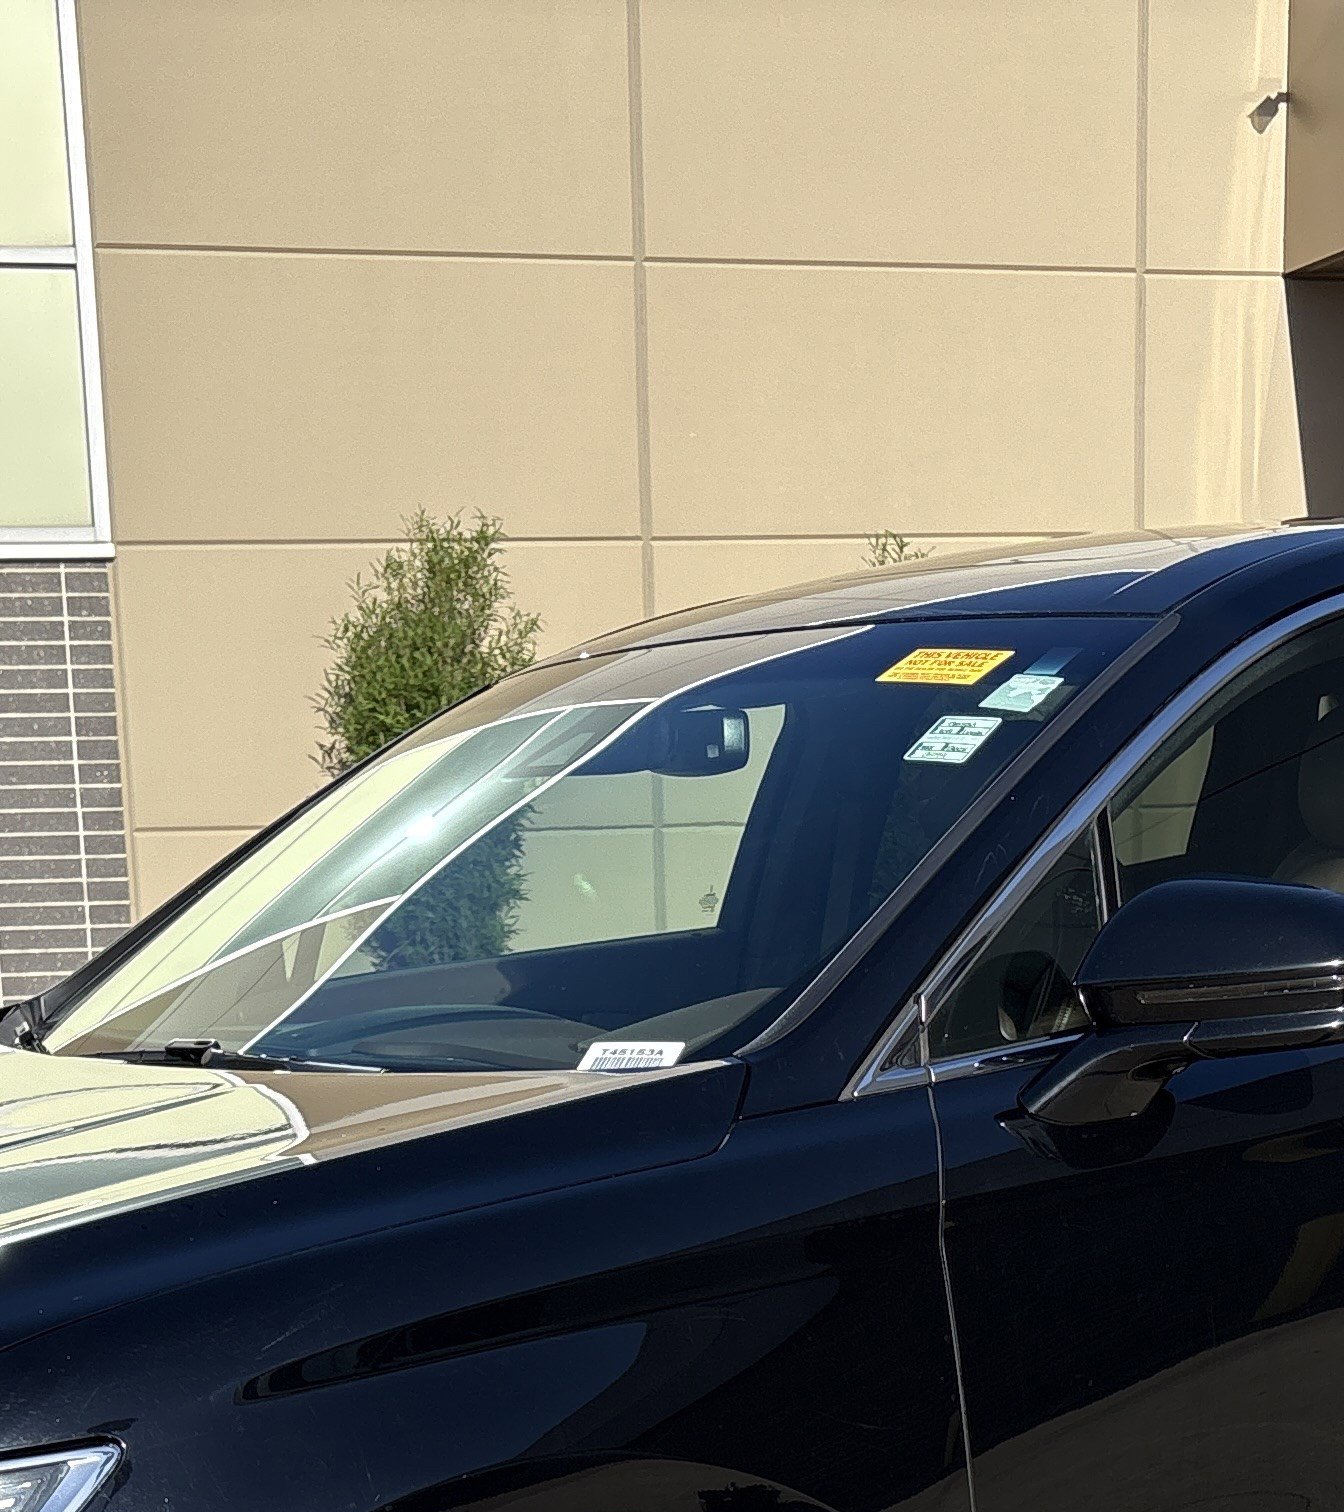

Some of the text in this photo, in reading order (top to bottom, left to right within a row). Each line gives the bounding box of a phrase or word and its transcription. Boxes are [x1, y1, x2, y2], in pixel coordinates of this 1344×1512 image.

[913, 651, 1004, 661] THIS VEHICLE
[955, 660, 990, 668] SALE
